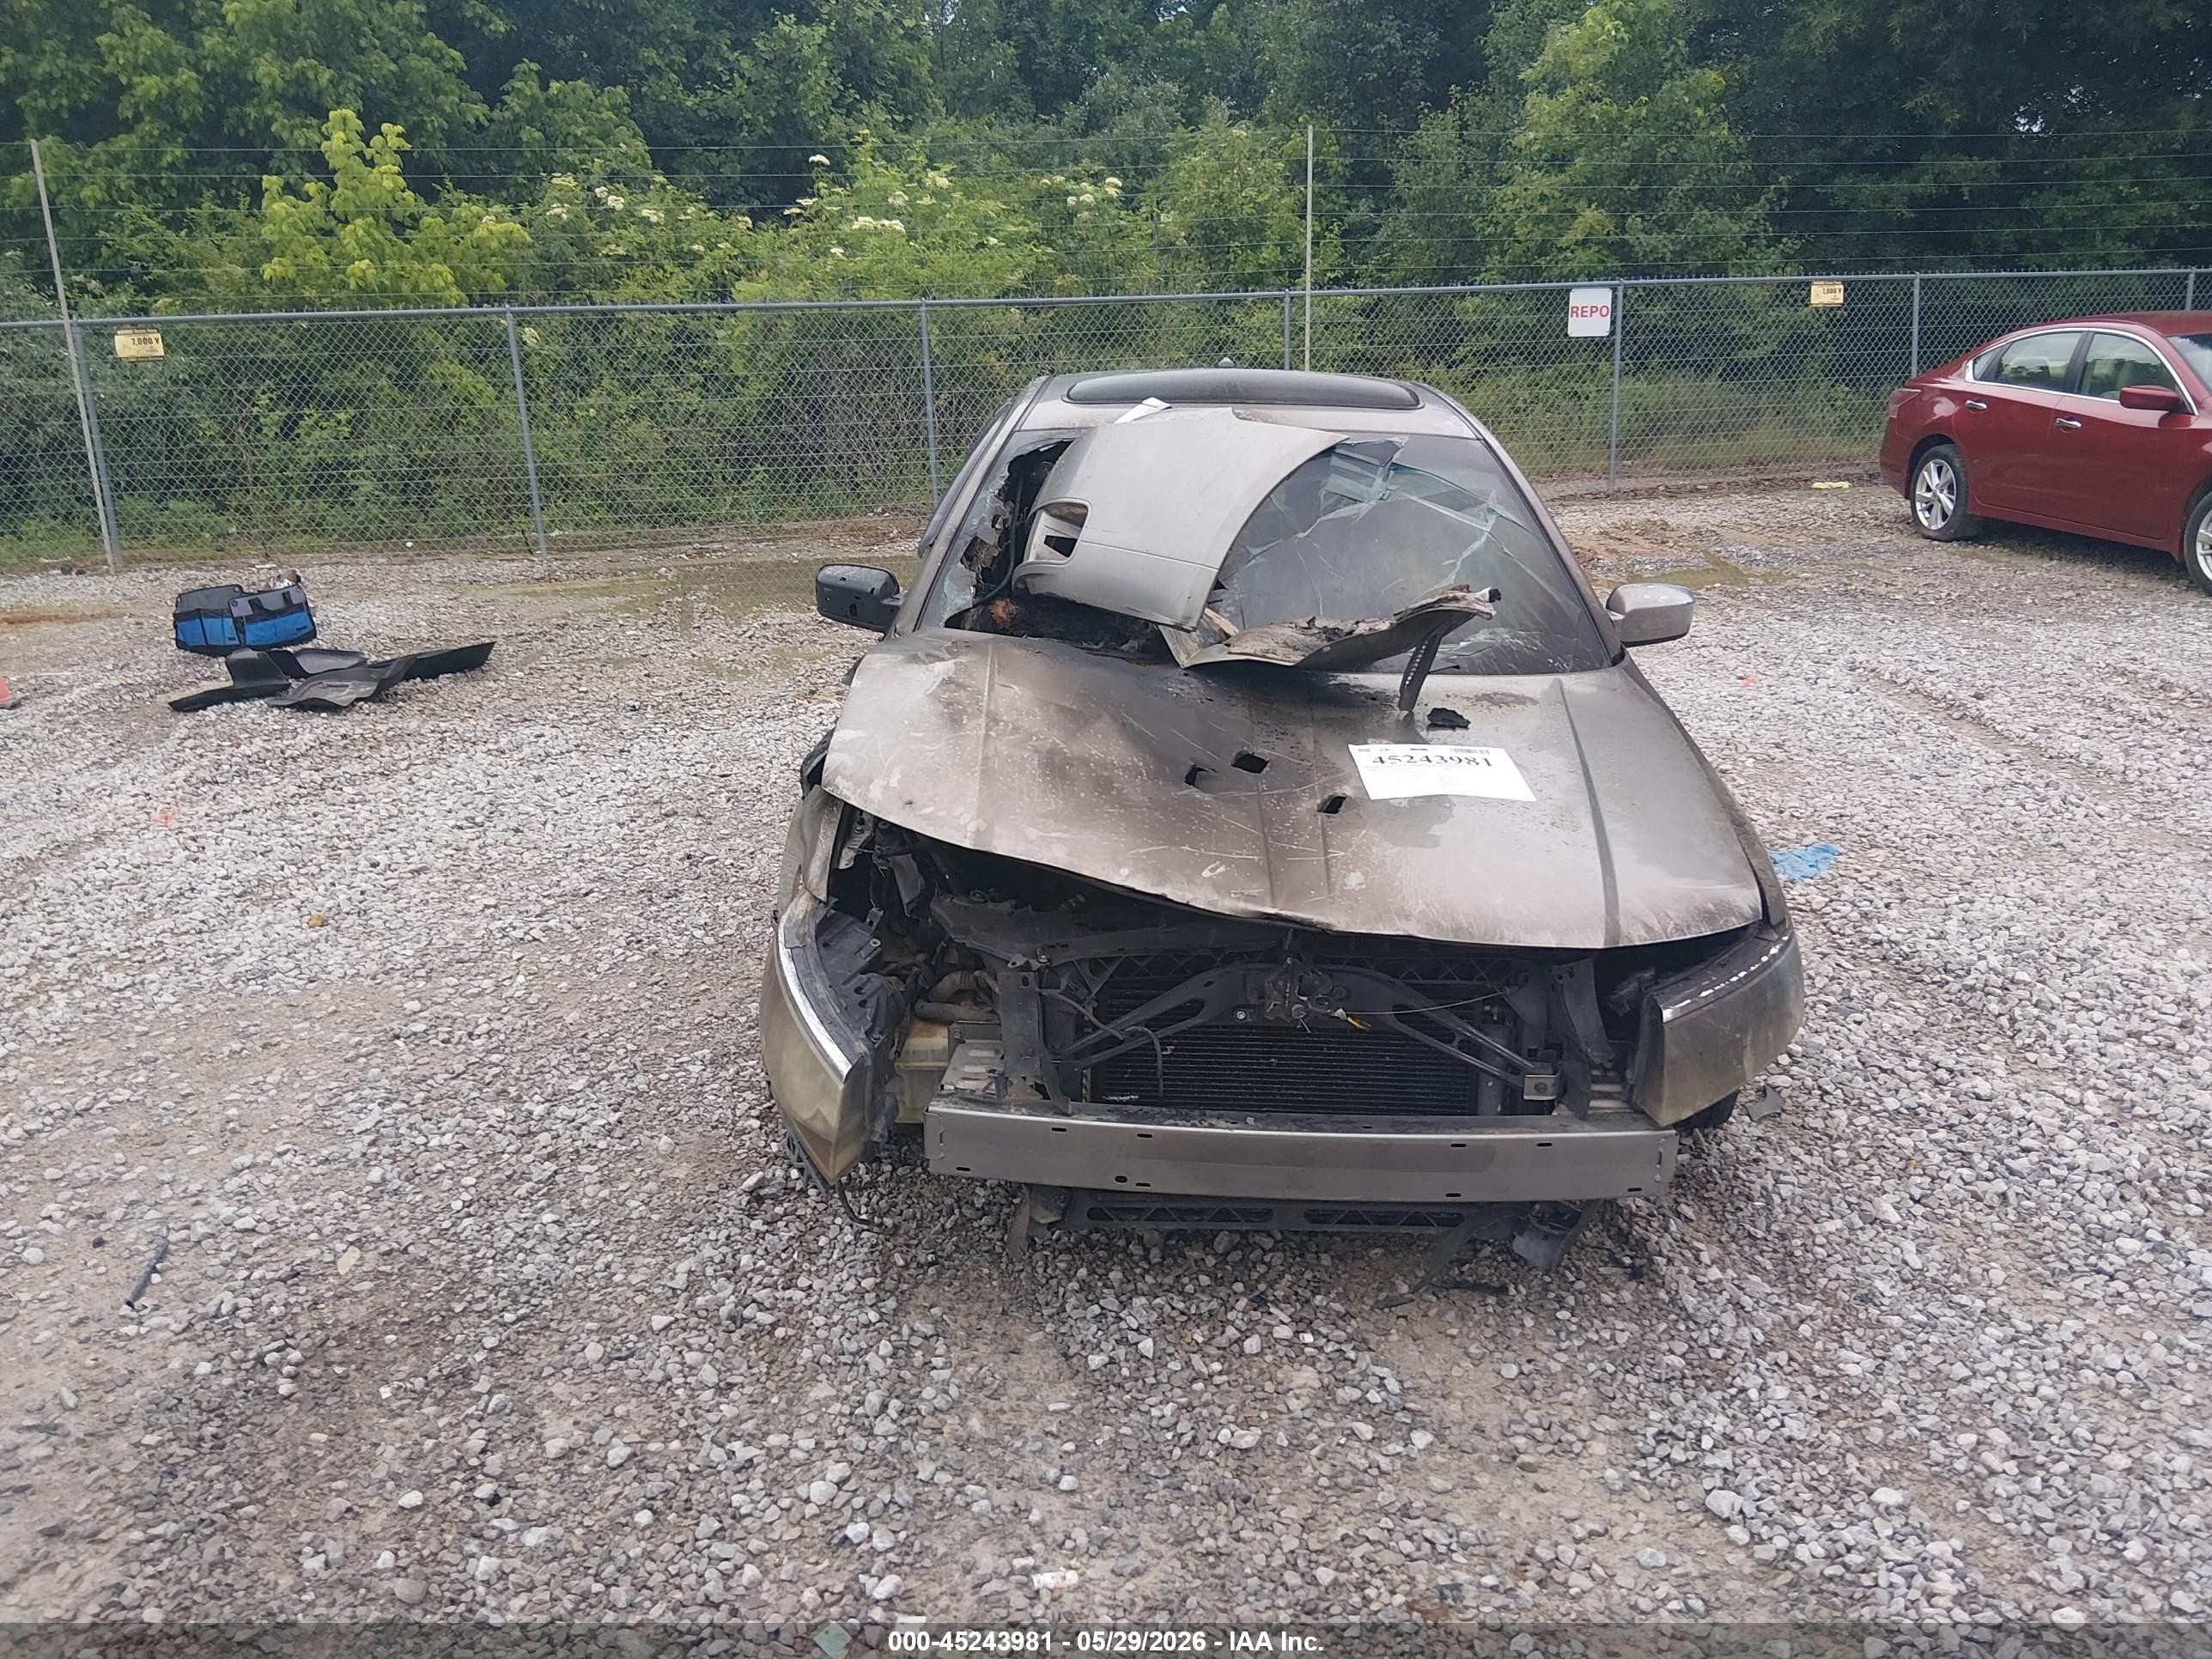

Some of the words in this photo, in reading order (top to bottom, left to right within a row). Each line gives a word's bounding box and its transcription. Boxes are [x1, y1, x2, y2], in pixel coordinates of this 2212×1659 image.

[1570, 305, 1610, 318] REPO
[131, 337, 154, 346] 7,000
[1372, 755, 1492, 767] 45243981
